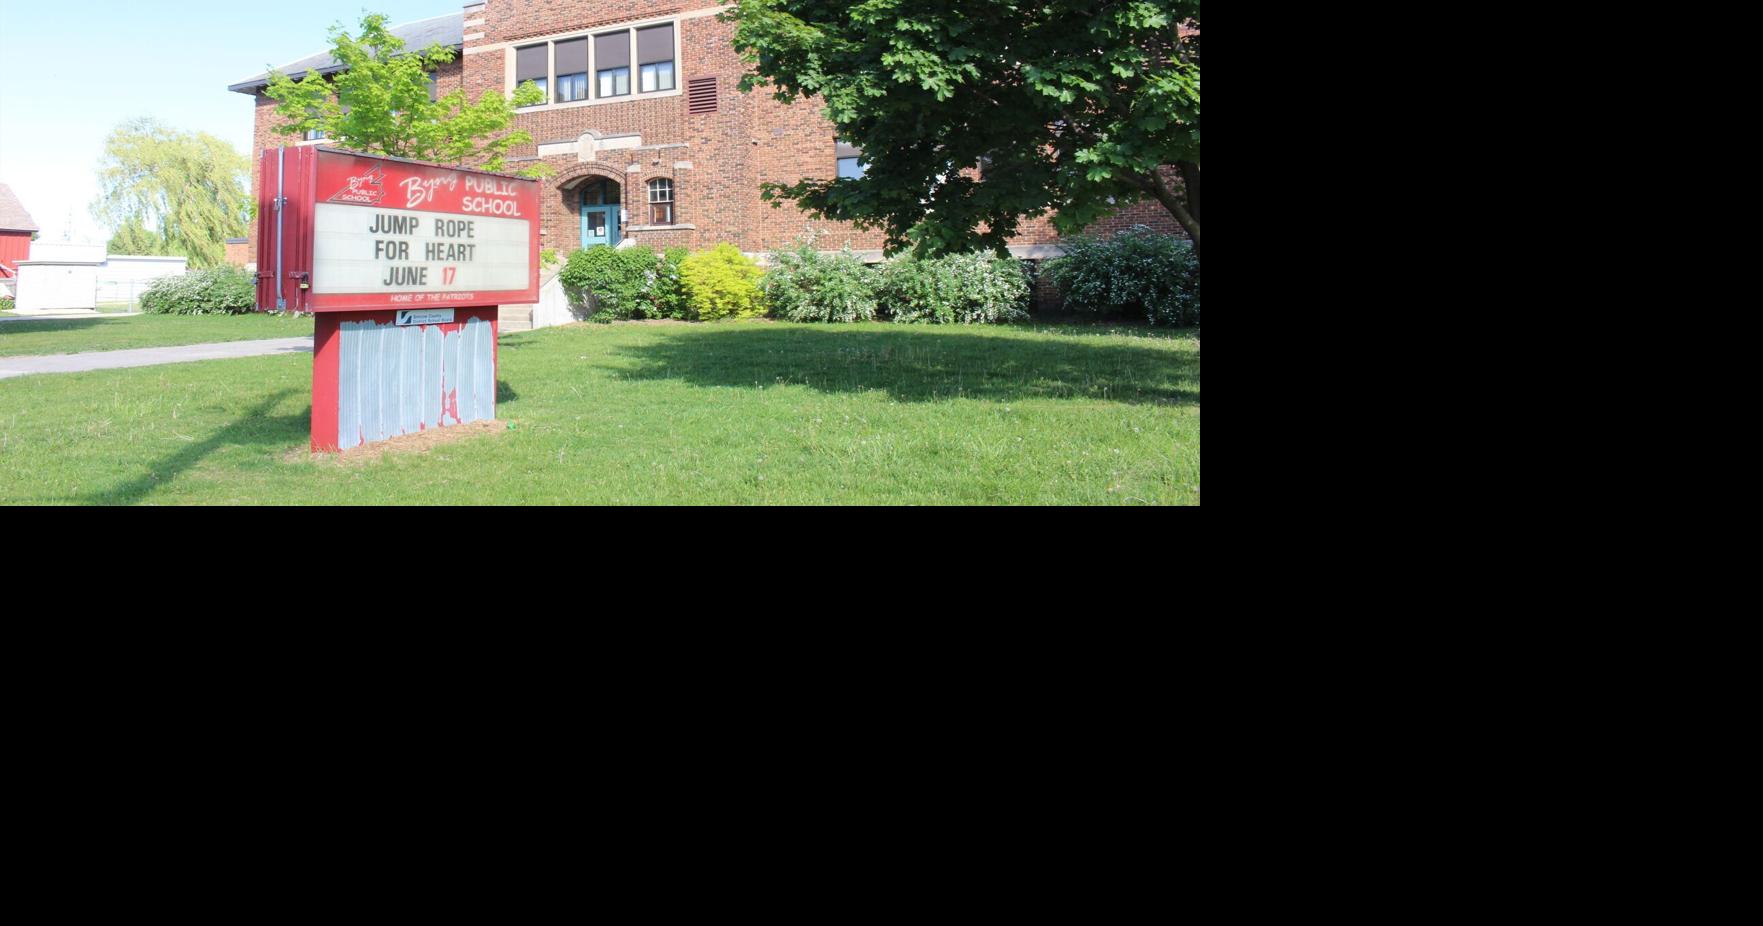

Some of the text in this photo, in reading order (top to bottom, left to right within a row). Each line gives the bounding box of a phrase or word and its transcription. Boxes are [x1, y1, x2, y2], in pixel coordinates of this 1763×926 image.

[342, 194, 372, 203] SCHOOL
[352, 188, 377, 197] PUBLIC
[400, 172, 518, 208] Byng PUBLIC
[462, 196, 521, 216] SCHOOL
[369, 214, 475, 239] JUMP ROPE
[374, 240, 476, 261] FOR HEART
[383, 266, 456, 286] JUNE 17
[390, 294, 413, 302] HOME
[427, 293, 441, 301] THE
